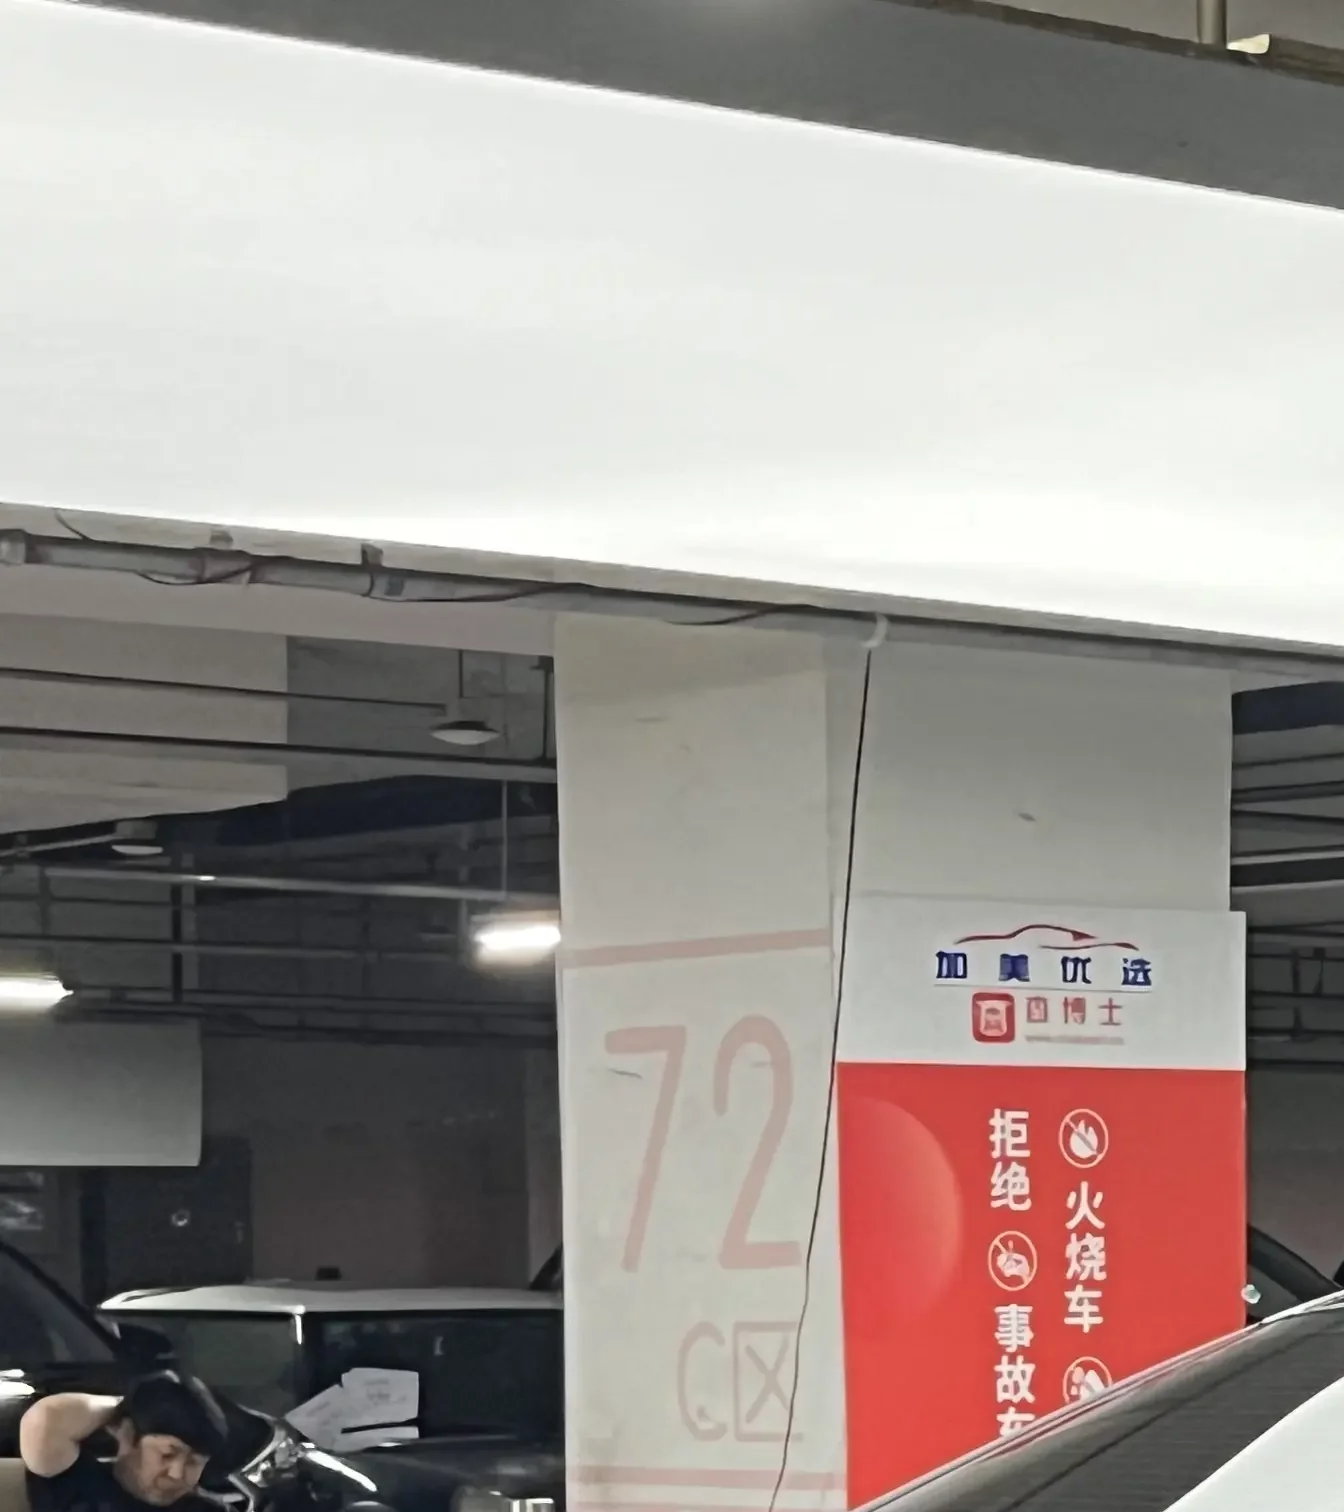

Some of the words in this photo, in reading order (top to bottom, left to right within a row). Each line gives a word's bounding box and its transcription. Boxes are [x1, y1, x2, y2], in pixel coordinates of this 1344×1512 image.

[604, 1014, 800, 1273] 72
[988, 1107, 1033, 1212] 拒绝
[1064, 1180, 1107, 1334] 火烧车
